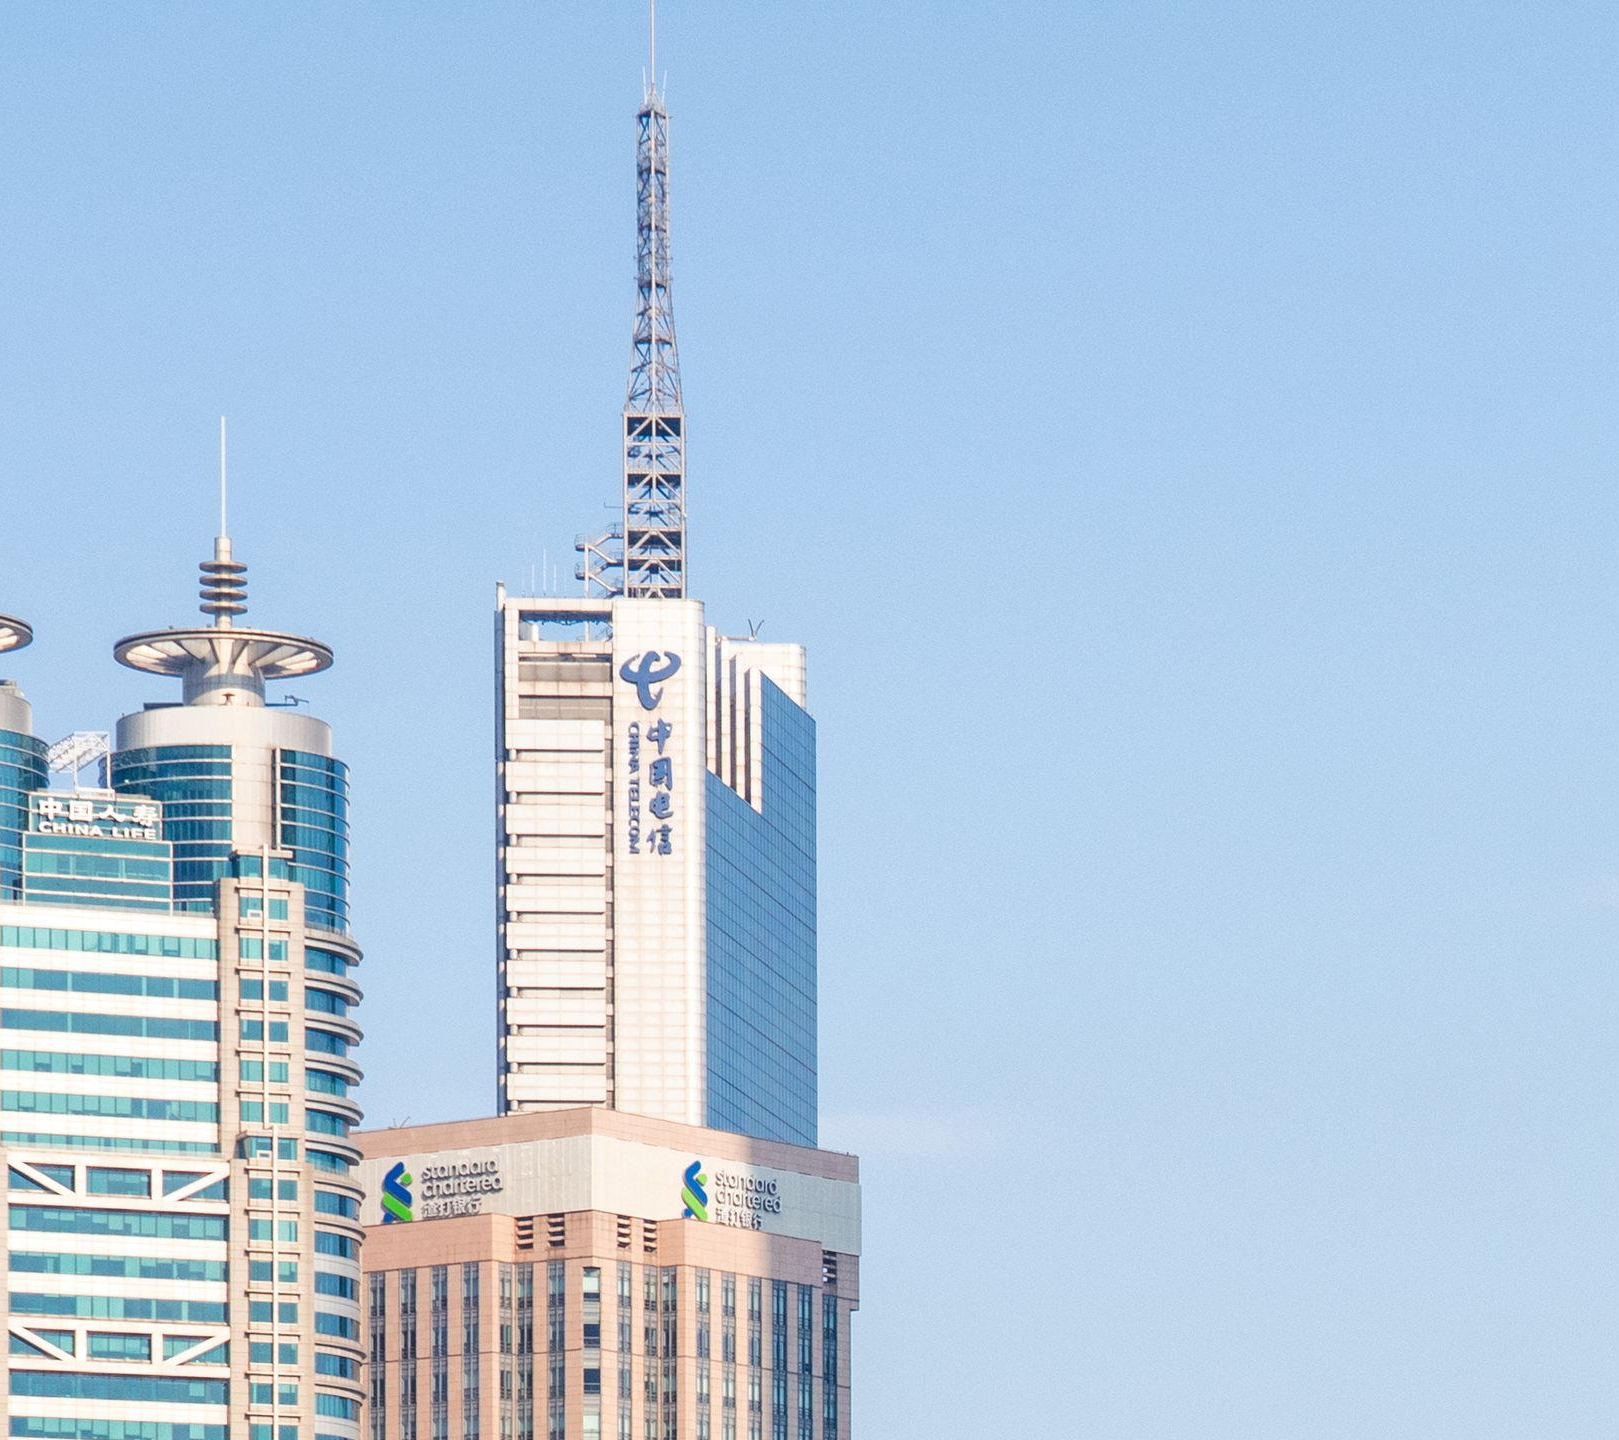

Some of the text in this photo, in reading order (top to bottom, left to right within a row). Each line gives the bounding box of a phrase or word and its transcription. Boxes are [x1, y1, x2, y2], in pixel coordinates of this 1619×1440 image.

[628, 721, 640, 855] CHINA TELECOM
[646, 717, 674, 856] 中国电信
[38, 797, 158, 827] 中国人寿
[38, 820, 157, 840] CHINA LIFE
[422, 1159, 498, 1180] standard
[715, 1169, 778, 1196] standard
[422, 1176, 503, 1200] chartered
[715, 1187, 782, 1214] chartered
[422, 1197, 482, 1219] 渣打银行
